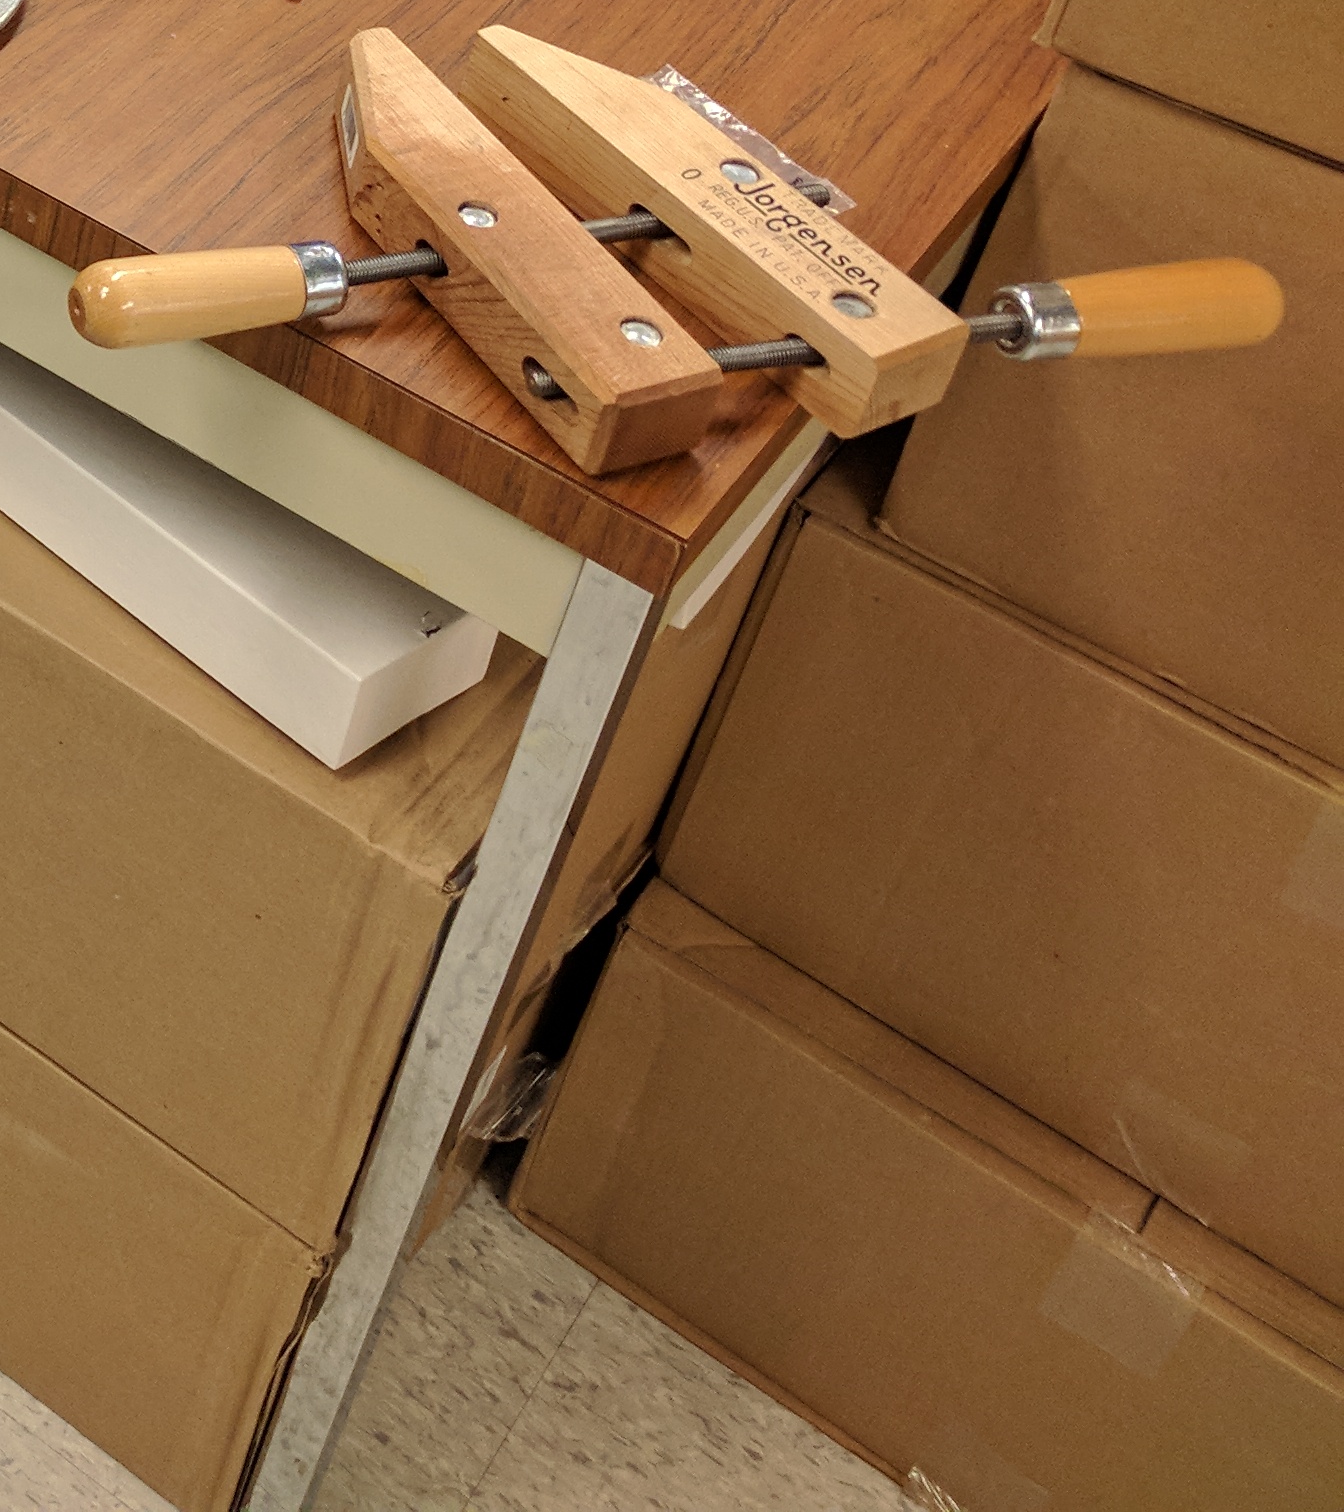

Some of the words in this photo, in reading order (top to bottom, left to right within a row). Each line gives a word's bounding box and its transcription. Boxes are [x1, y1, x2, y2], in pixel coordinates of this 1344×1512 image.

[698, 199, 750, 239] MADE
[749, 240, 774, 260] IN
[734, 183, 883, 298] Jorgensen
